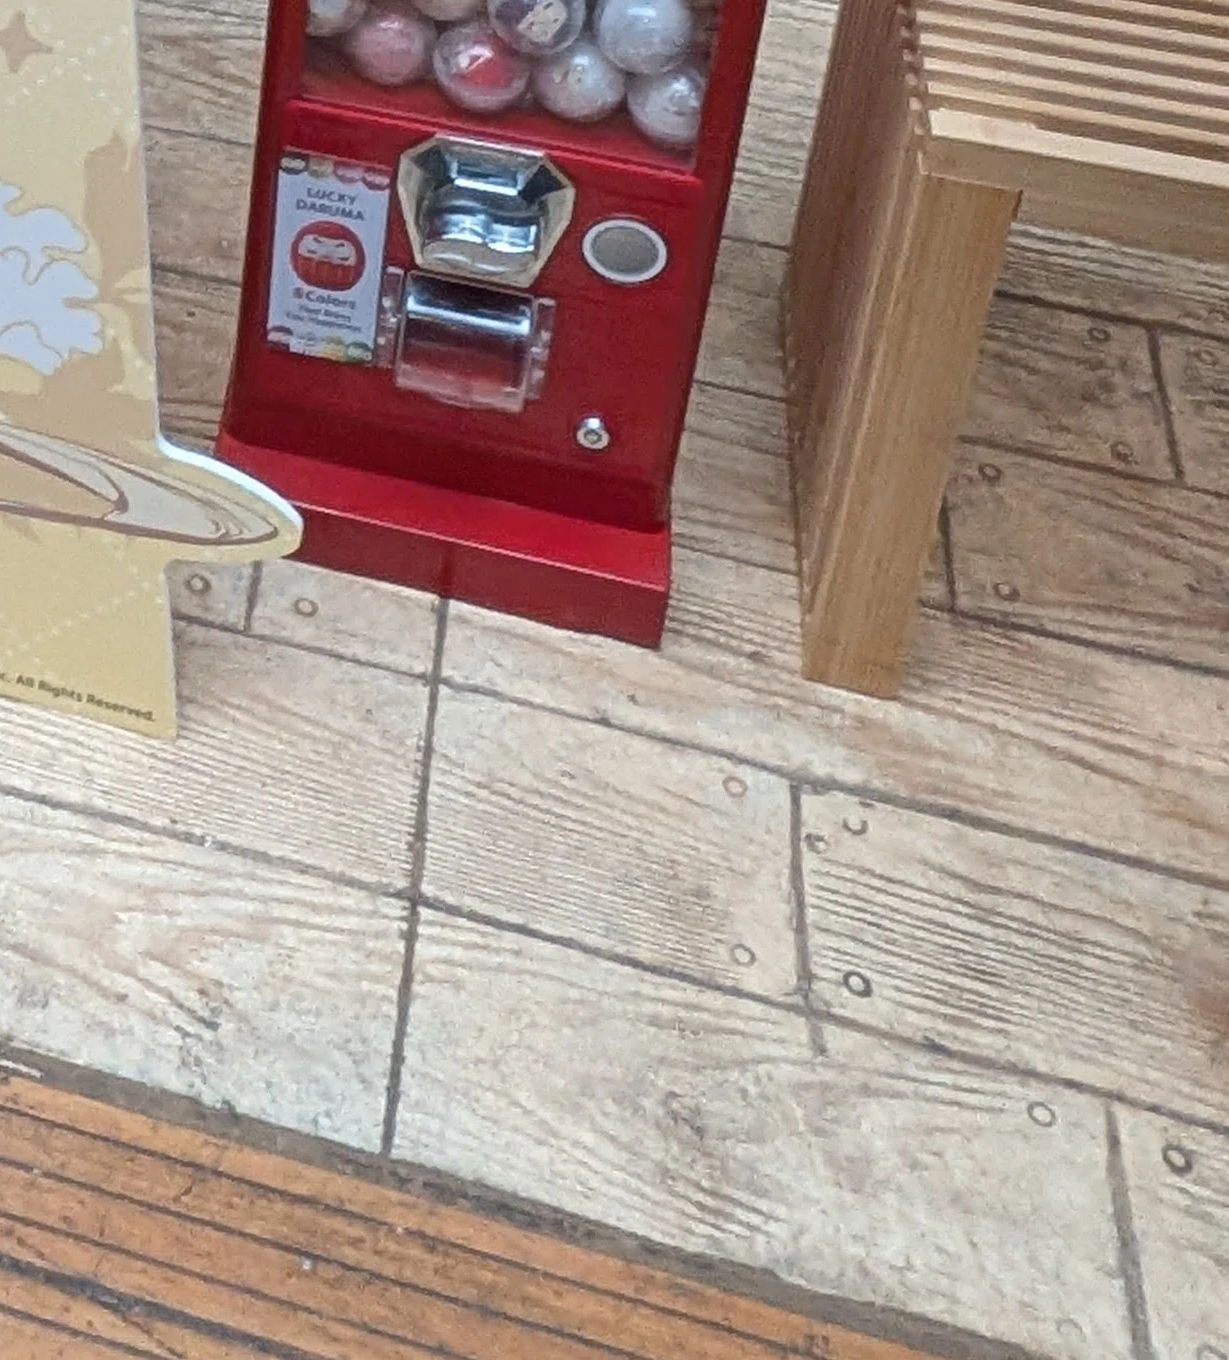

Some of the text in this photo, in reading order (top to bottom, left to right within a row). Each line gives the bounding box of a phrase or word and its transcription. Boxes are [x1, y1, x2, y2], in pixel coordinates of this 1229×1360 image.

[306, 187, 358, 206] LUCKY
[295, 199, 366, 221] DARUMA
[16, 674, 35, 688] All
[38, 680, 84, 704] Rights
[86, 693, 157, 722] Reserved.
